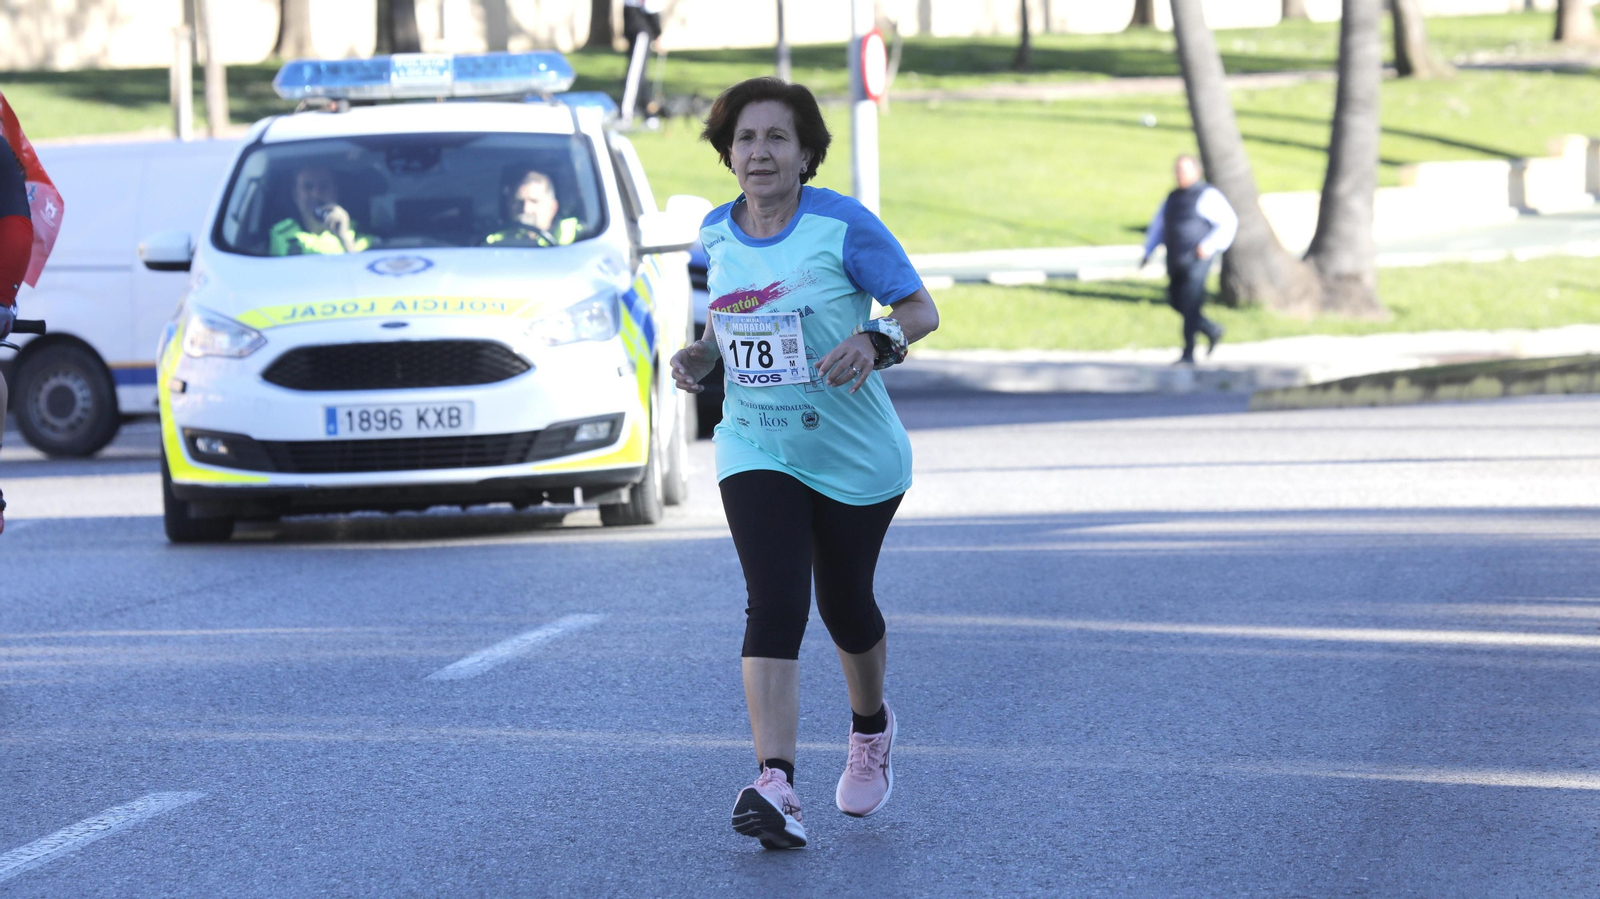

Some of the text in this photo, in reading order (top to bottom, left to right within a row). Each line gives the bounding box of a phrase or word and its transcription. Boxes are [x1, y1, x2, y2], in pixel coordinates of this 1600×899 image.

[732, 321, 772, 331] MARATÓN
[729, 340, 774, 369] 178
[738, 374, 782, 384] EVOS
[775, 403, 816, 411] ANDALUSIA
[346, 406, 462, 432] 1896 KXB
[759, 412, 788, 427] ikos
